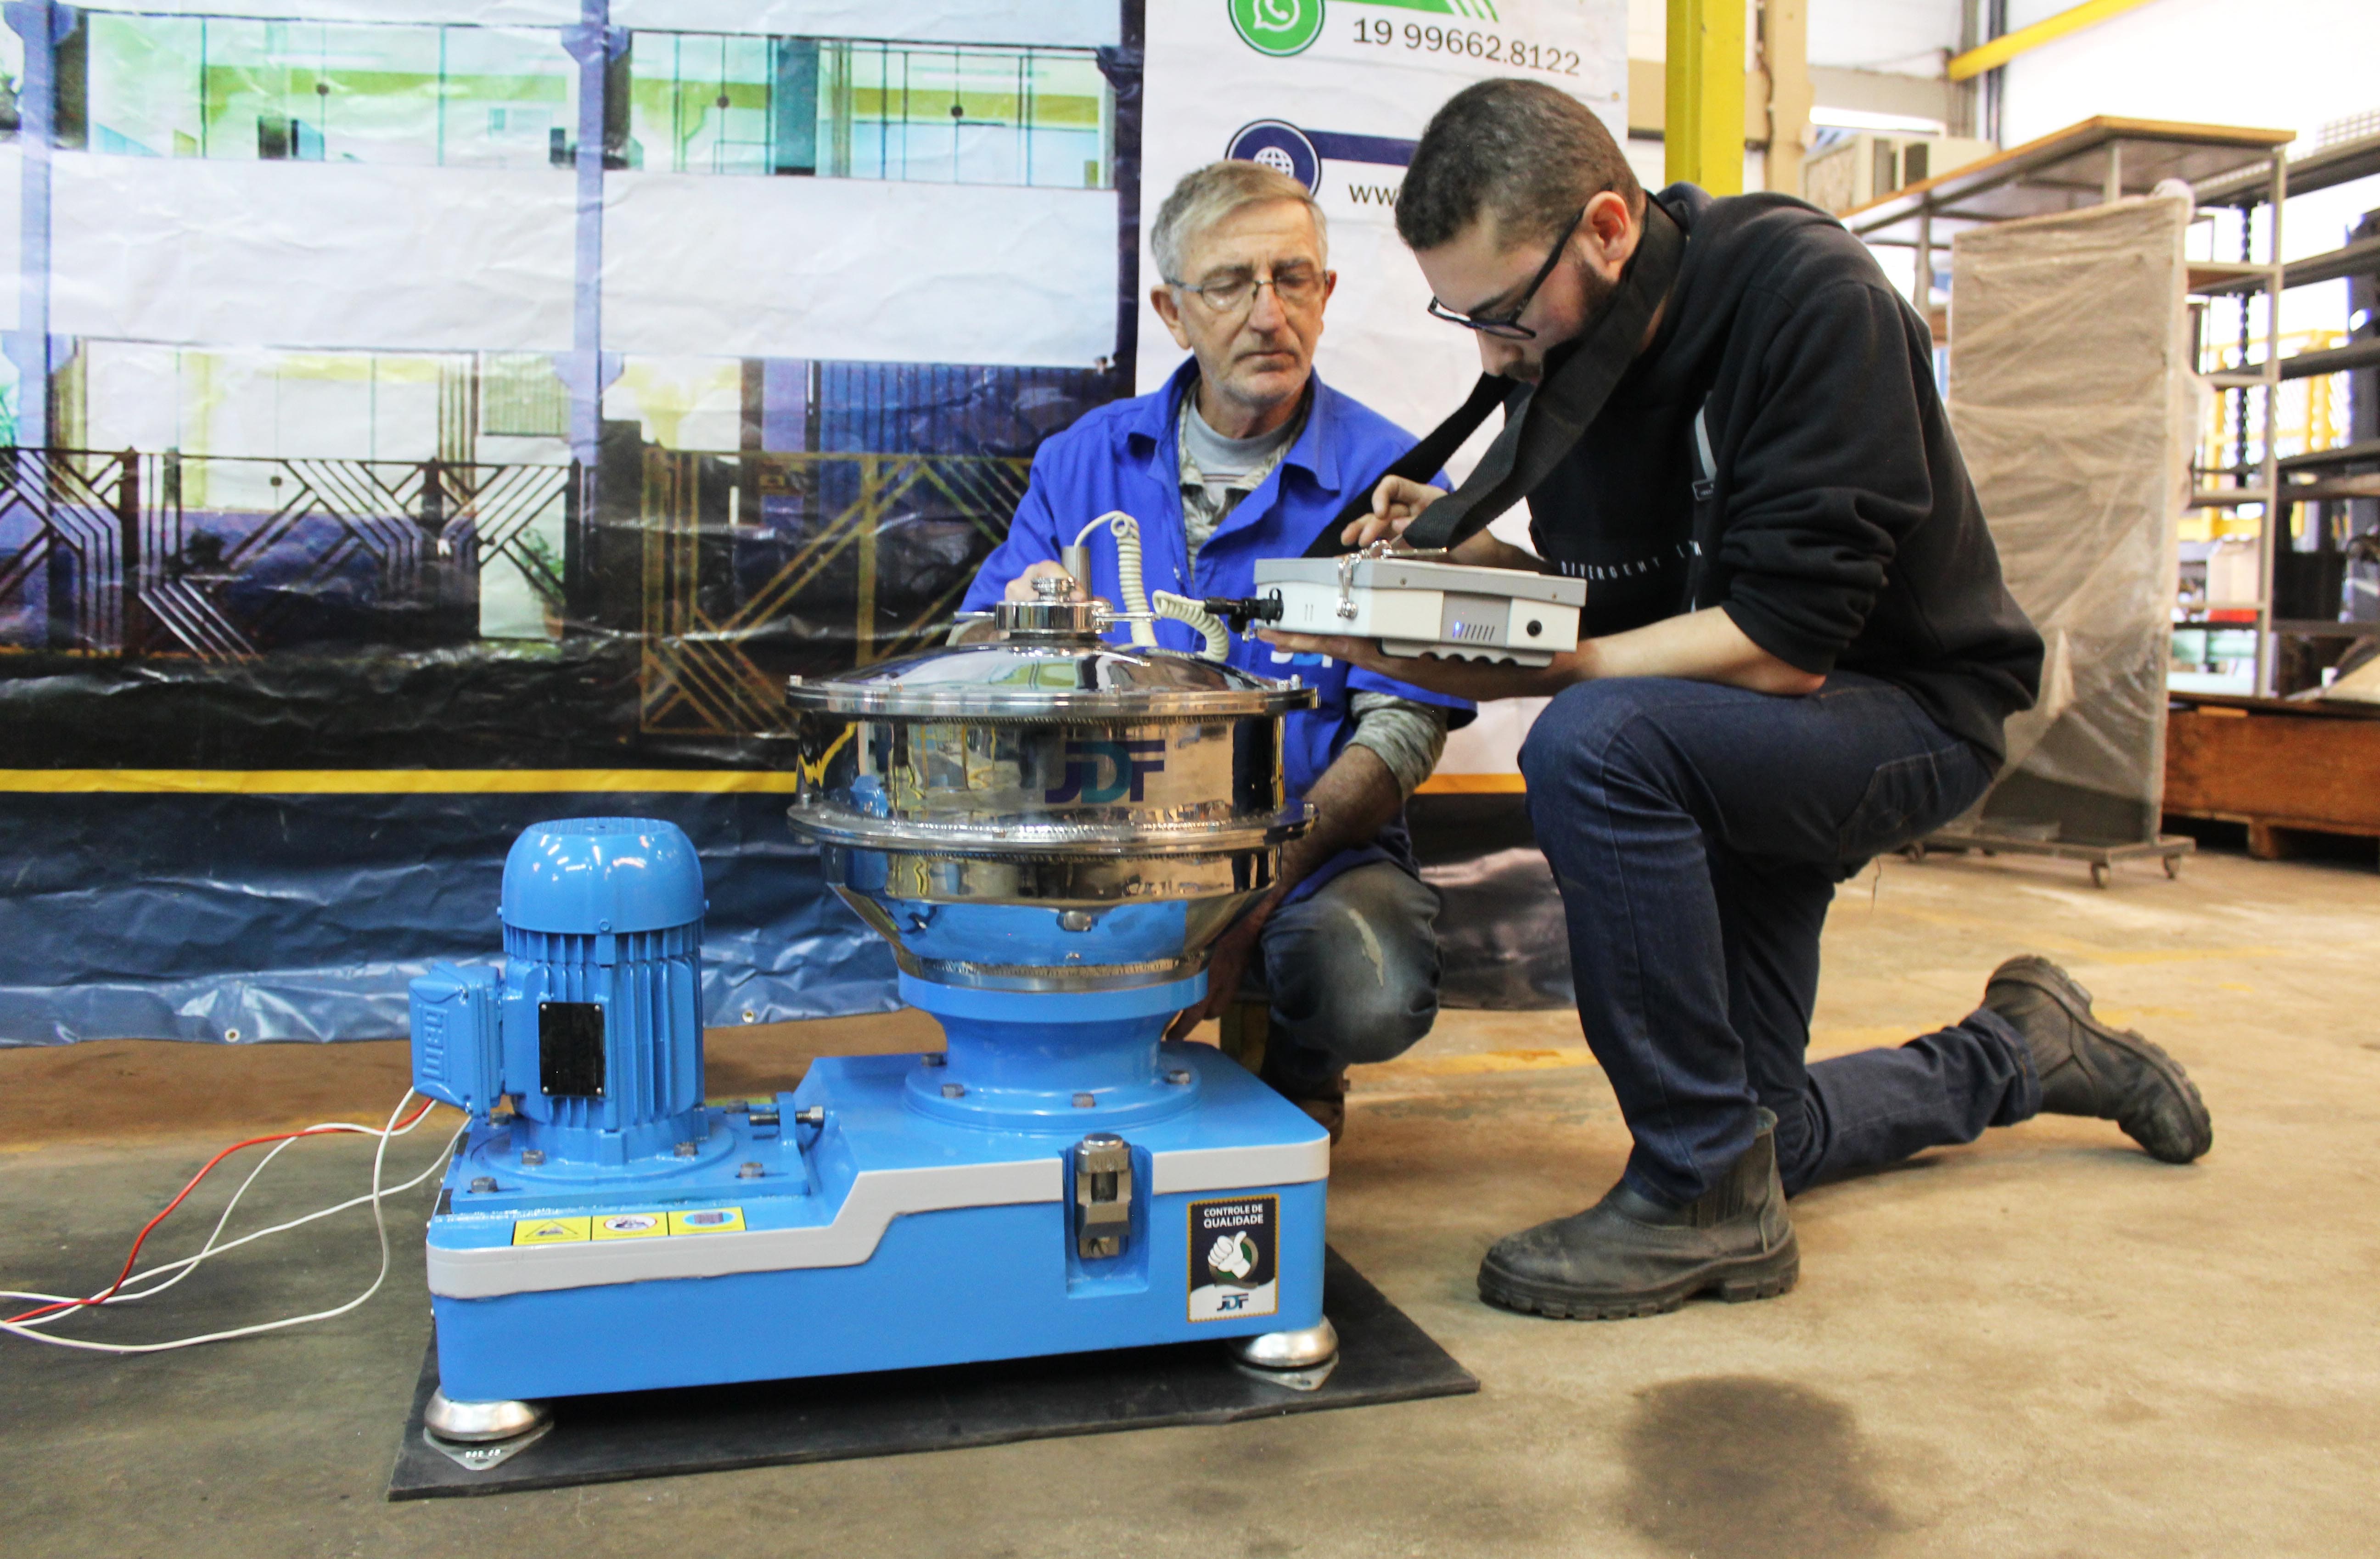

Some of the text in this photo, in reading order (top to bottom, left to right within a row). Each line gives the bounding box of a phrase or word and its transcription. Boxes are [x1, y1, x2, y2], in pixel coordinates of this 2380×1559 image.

[1353, 17, 1580, 76] 19 99662.8122
[1348, 183, 1398, 207] ww
[1045, 740, 1166, 803] JDF
[1203, 1213, 1264, 1229] QUALIDADE
[1204, 1203, 1263, 1218] CONTROLE DE
[1217, 1292, 1249, 1311] JDF
